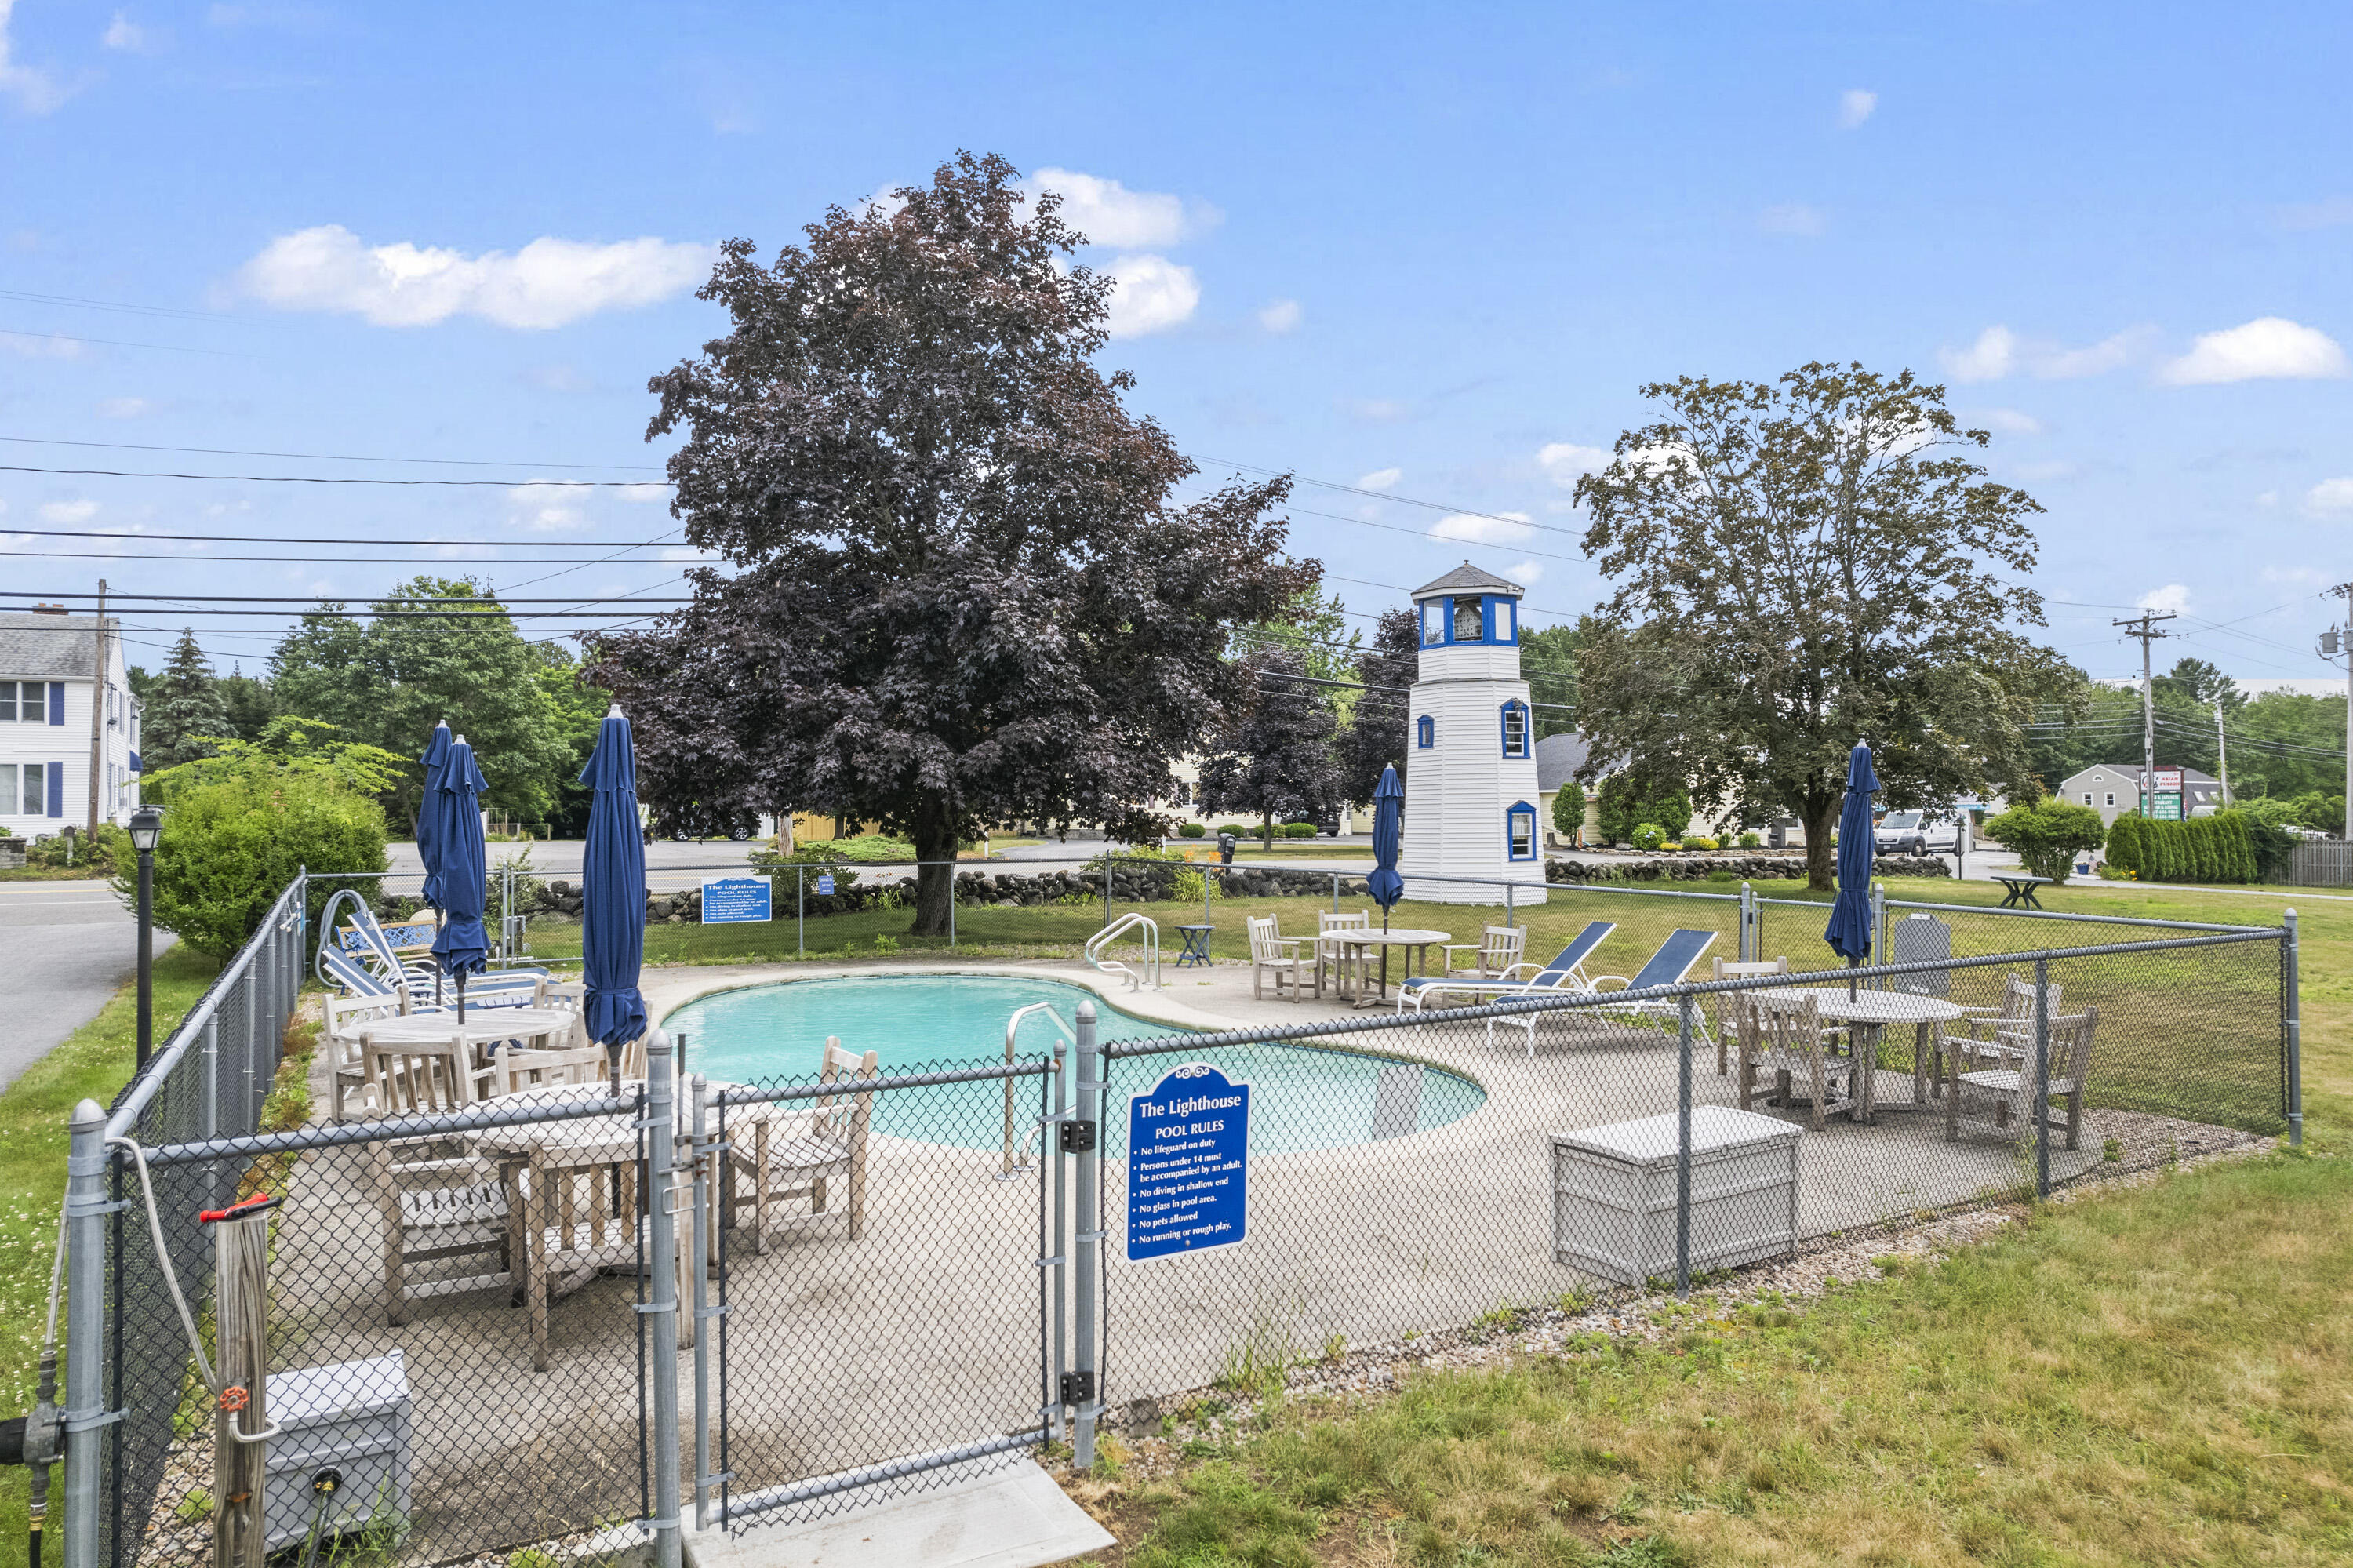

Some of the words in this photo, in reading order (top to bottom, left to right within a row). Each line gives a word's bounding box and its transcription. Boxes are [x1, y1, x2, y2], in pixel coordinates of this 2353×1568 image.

[1140, 1102, 1165, 1118] The
[1169, 1095, 1241, 1117] Lighthouse
[1156, 1125, 1188, 1139] POOL
[1191, 1120, 1224, 1134] RULES
[1155, 1141, 1187, 1154] lifeguard
[1199, 1139, 1216, 1148] duty
[1140, 1160, 1168, 1171] Persons
[1170, 1157, 1191, 1167] under
[1204, 1153, 1222, 1162] must
[1140, 1174, 1149, 1182] be
[1151, 1166, 1199, 1181] accompanied
[1201, 1165, 1209, 1175] by
[1222, 1160, 1242, 1170] adult.
[1140, 1190, 1151, 1198] No
[1153, 1185, 1176, 1196] diving
[1177, 1184, 1185, 1192] in
[1186, 1179, 1213, 1190] shallow
[1215, 1176, 1229, 1186] end
[1153, 1201, 1170, 1213] glass
[1172, 1199, 1179, 1208] in
[1181, 1196, 1198, 1209] pool
[1153, 1218, 1168, 1229] pets
[1170, 1211, 1198, 1224] allowed
[1152, 1230, 1181, 1241] running
[1192, 1224, 1213, 1235] rough
[1215, 1221, 1231, 1233] play.
